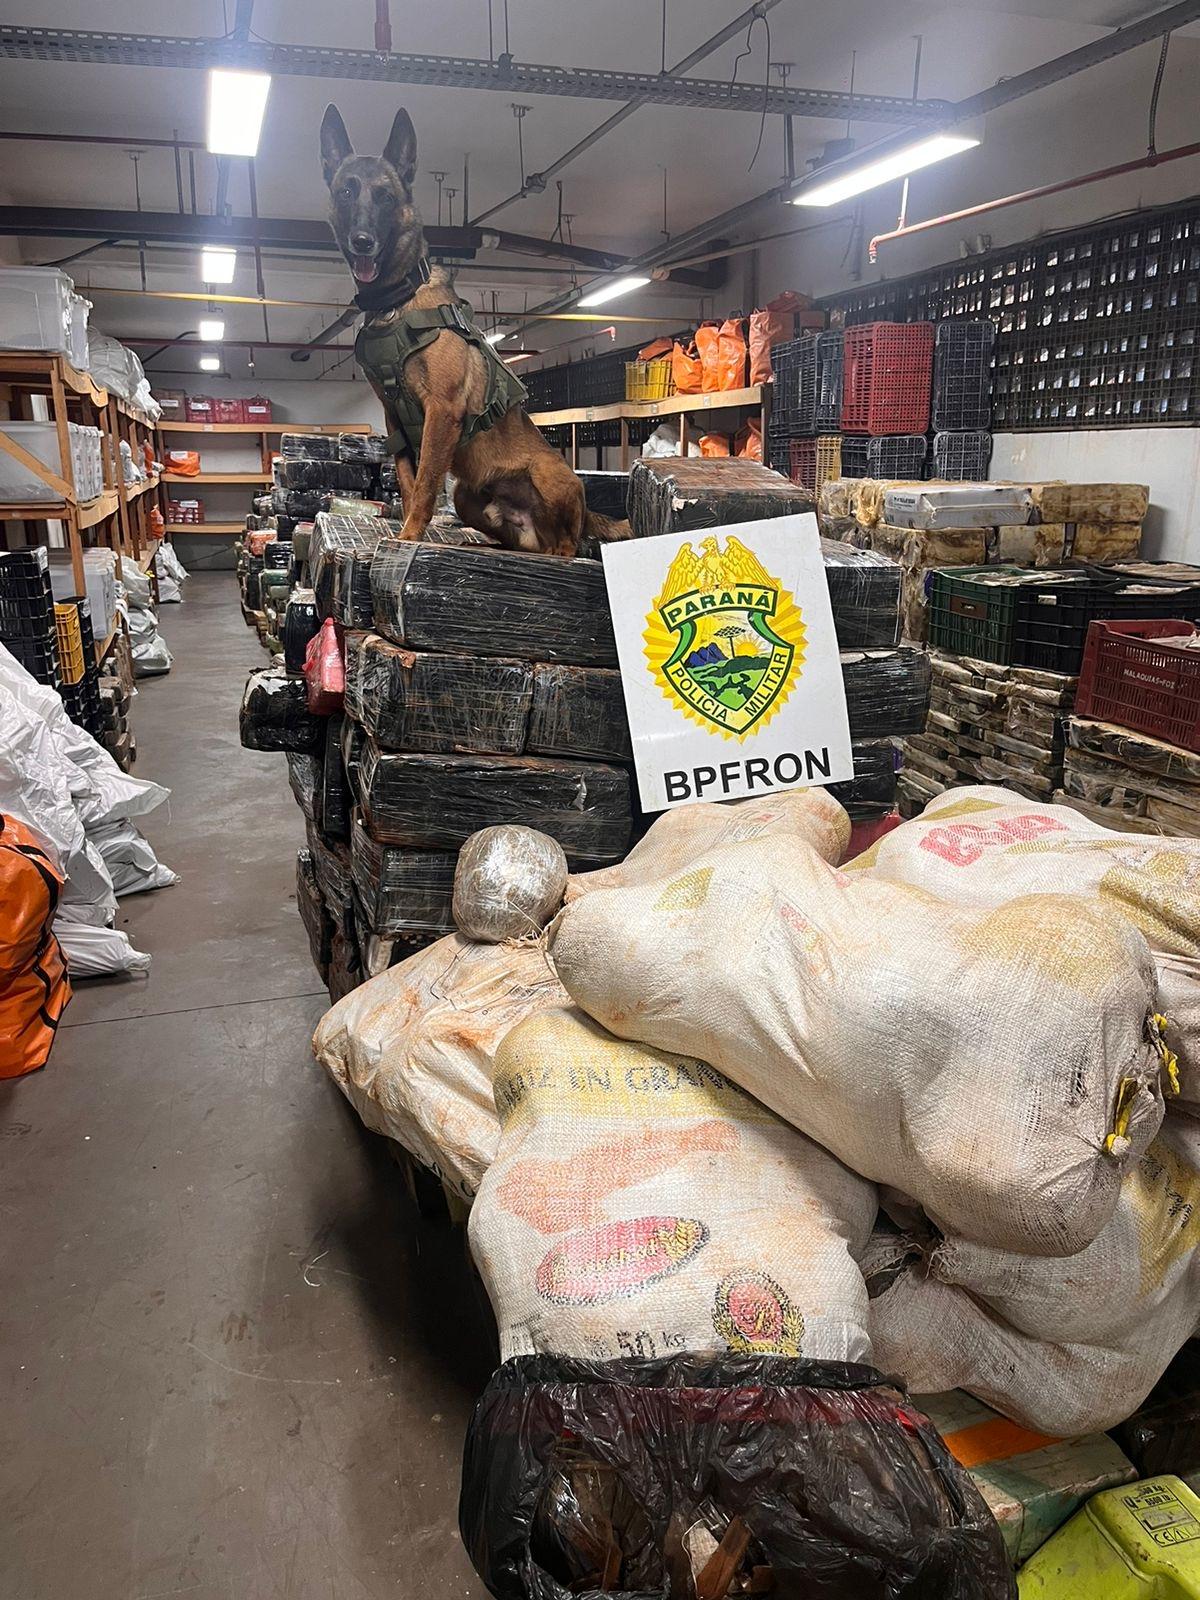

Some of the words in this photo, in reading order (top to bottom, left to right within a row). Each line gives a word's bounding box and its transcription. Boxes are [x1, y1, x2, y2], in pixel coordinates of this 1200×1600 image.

[667, 588, 771, 623] PARANÁ
[744, 652, 788, 718] MILITAR
[663, 746, 832, 803] BPFRON
